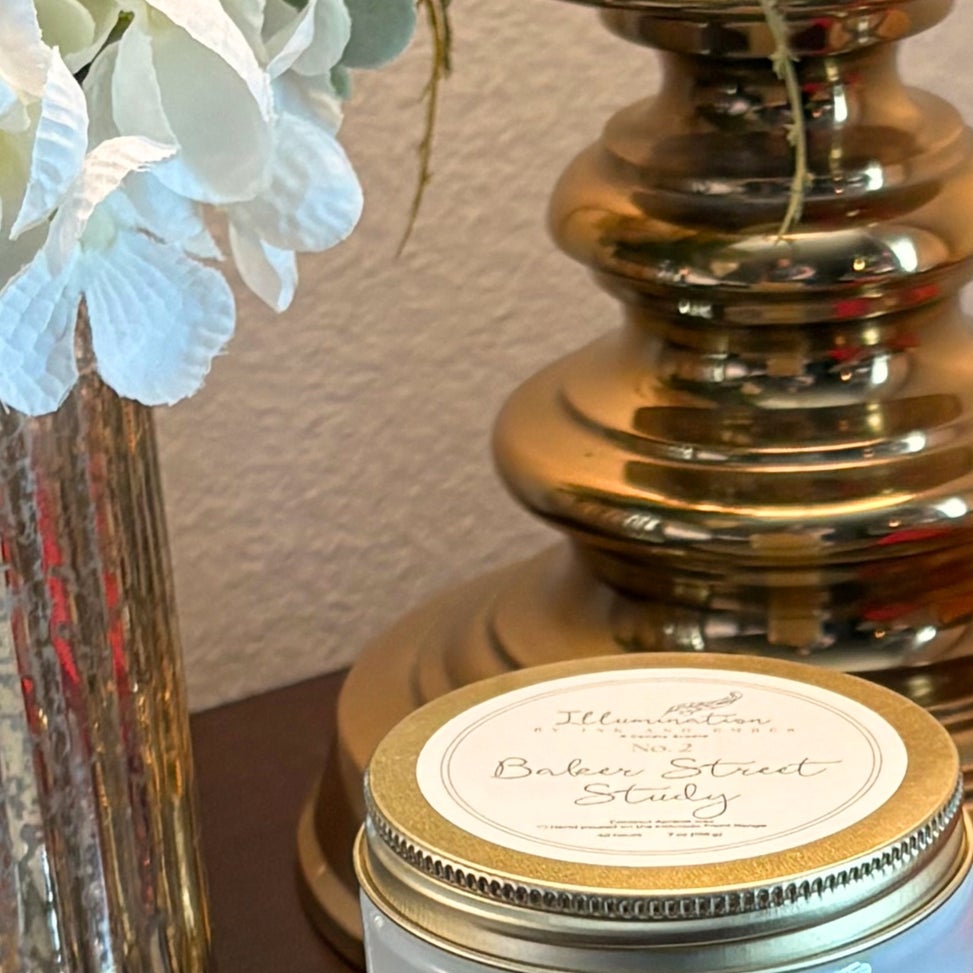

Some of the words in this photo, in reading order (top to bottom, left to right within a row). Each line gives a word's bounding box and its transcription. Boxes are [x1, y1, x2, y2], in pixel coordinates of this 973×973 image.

[555, 711, 770, 726] Illumination
[679, 743, 692, 753] 2
[492, 757, 645, 780] Baker
[660, 757, 843, 780] Street
[574, 783, 742, 819] Study
